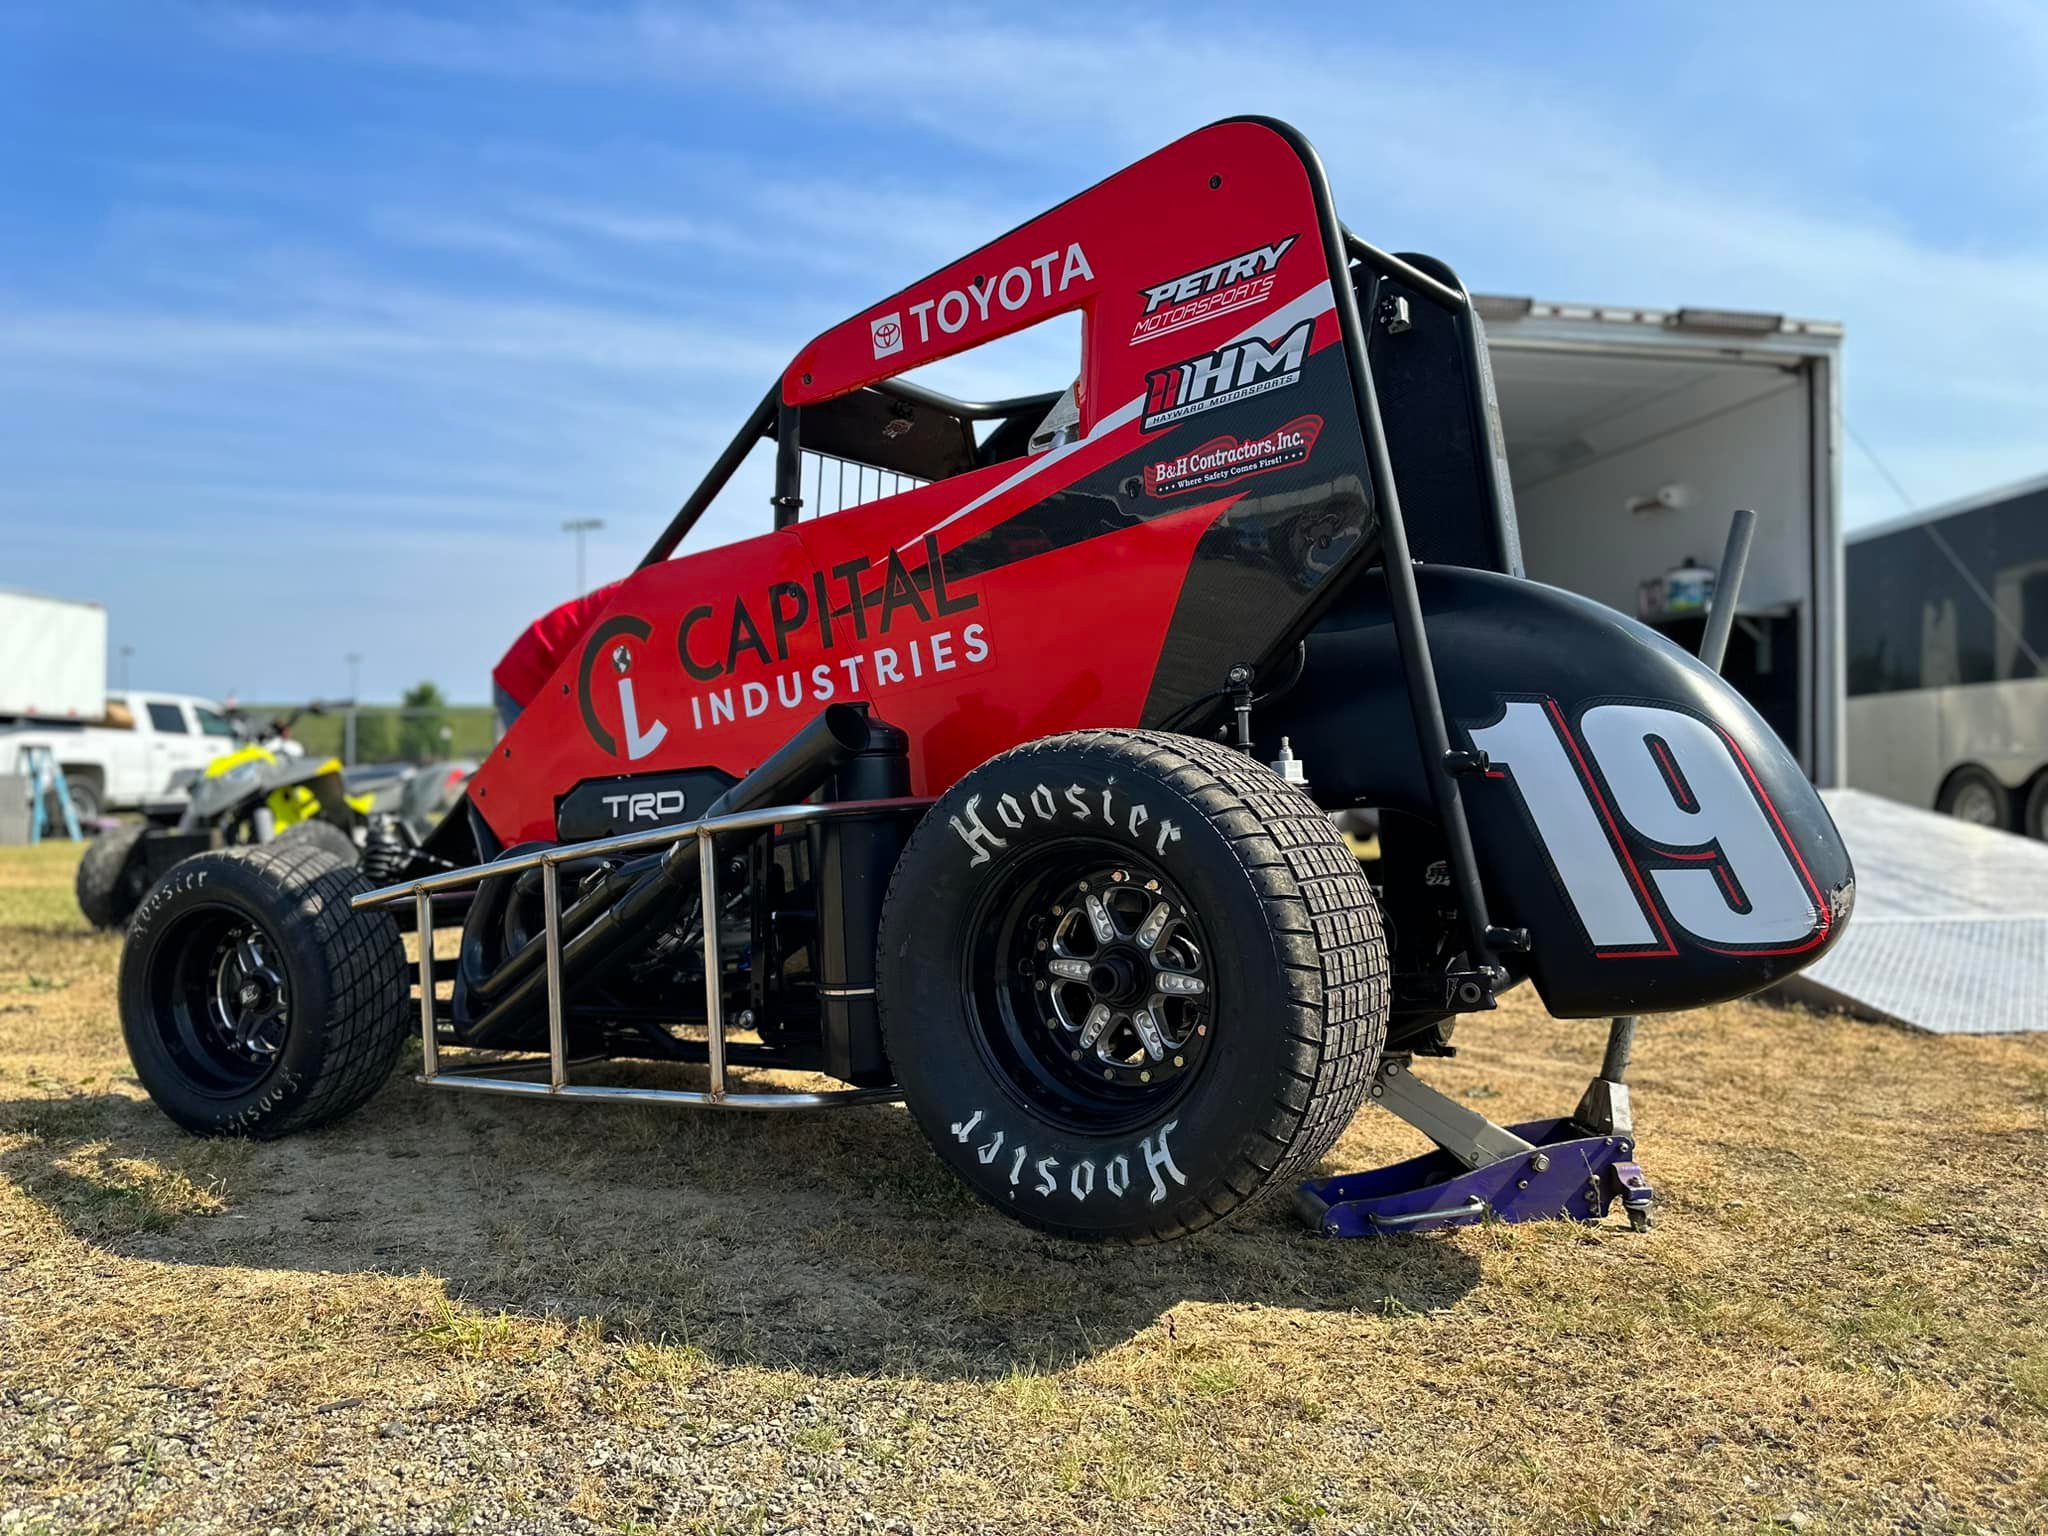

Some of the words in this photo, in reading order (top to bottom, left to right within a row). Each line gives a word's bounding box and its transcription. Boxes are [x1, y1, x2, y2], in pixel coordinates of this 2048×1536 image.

[909, 243, 1095, 343] TOYOTA
[1132, 274, 1277, 336] MOTORSPORTS
[1141, 234, 1298, 315] PETRY
[1152, 402, 1205, 425] HAYWARD
[1209, 375, 1294, 407] MOTORSPORTS
[1155, 457, 1187, 482] B&H
[1177, 477, 1202, 489] Where
[1203, 470, 1229, 483] Safety
[1230, 463, 1258, 475] Comes
[1259, 456, 1283, 469] First!
[678, 534, 979, 682] CAPITAL
[691, 623, 989, 730] INDUSTRIES
[602, 790, 685, 822] TRD
[949, 775, 1181, 868] Hoosier
[1466, 699, 1822, 948] 19
[951, 1110, 1188, 1203] Hoosier
